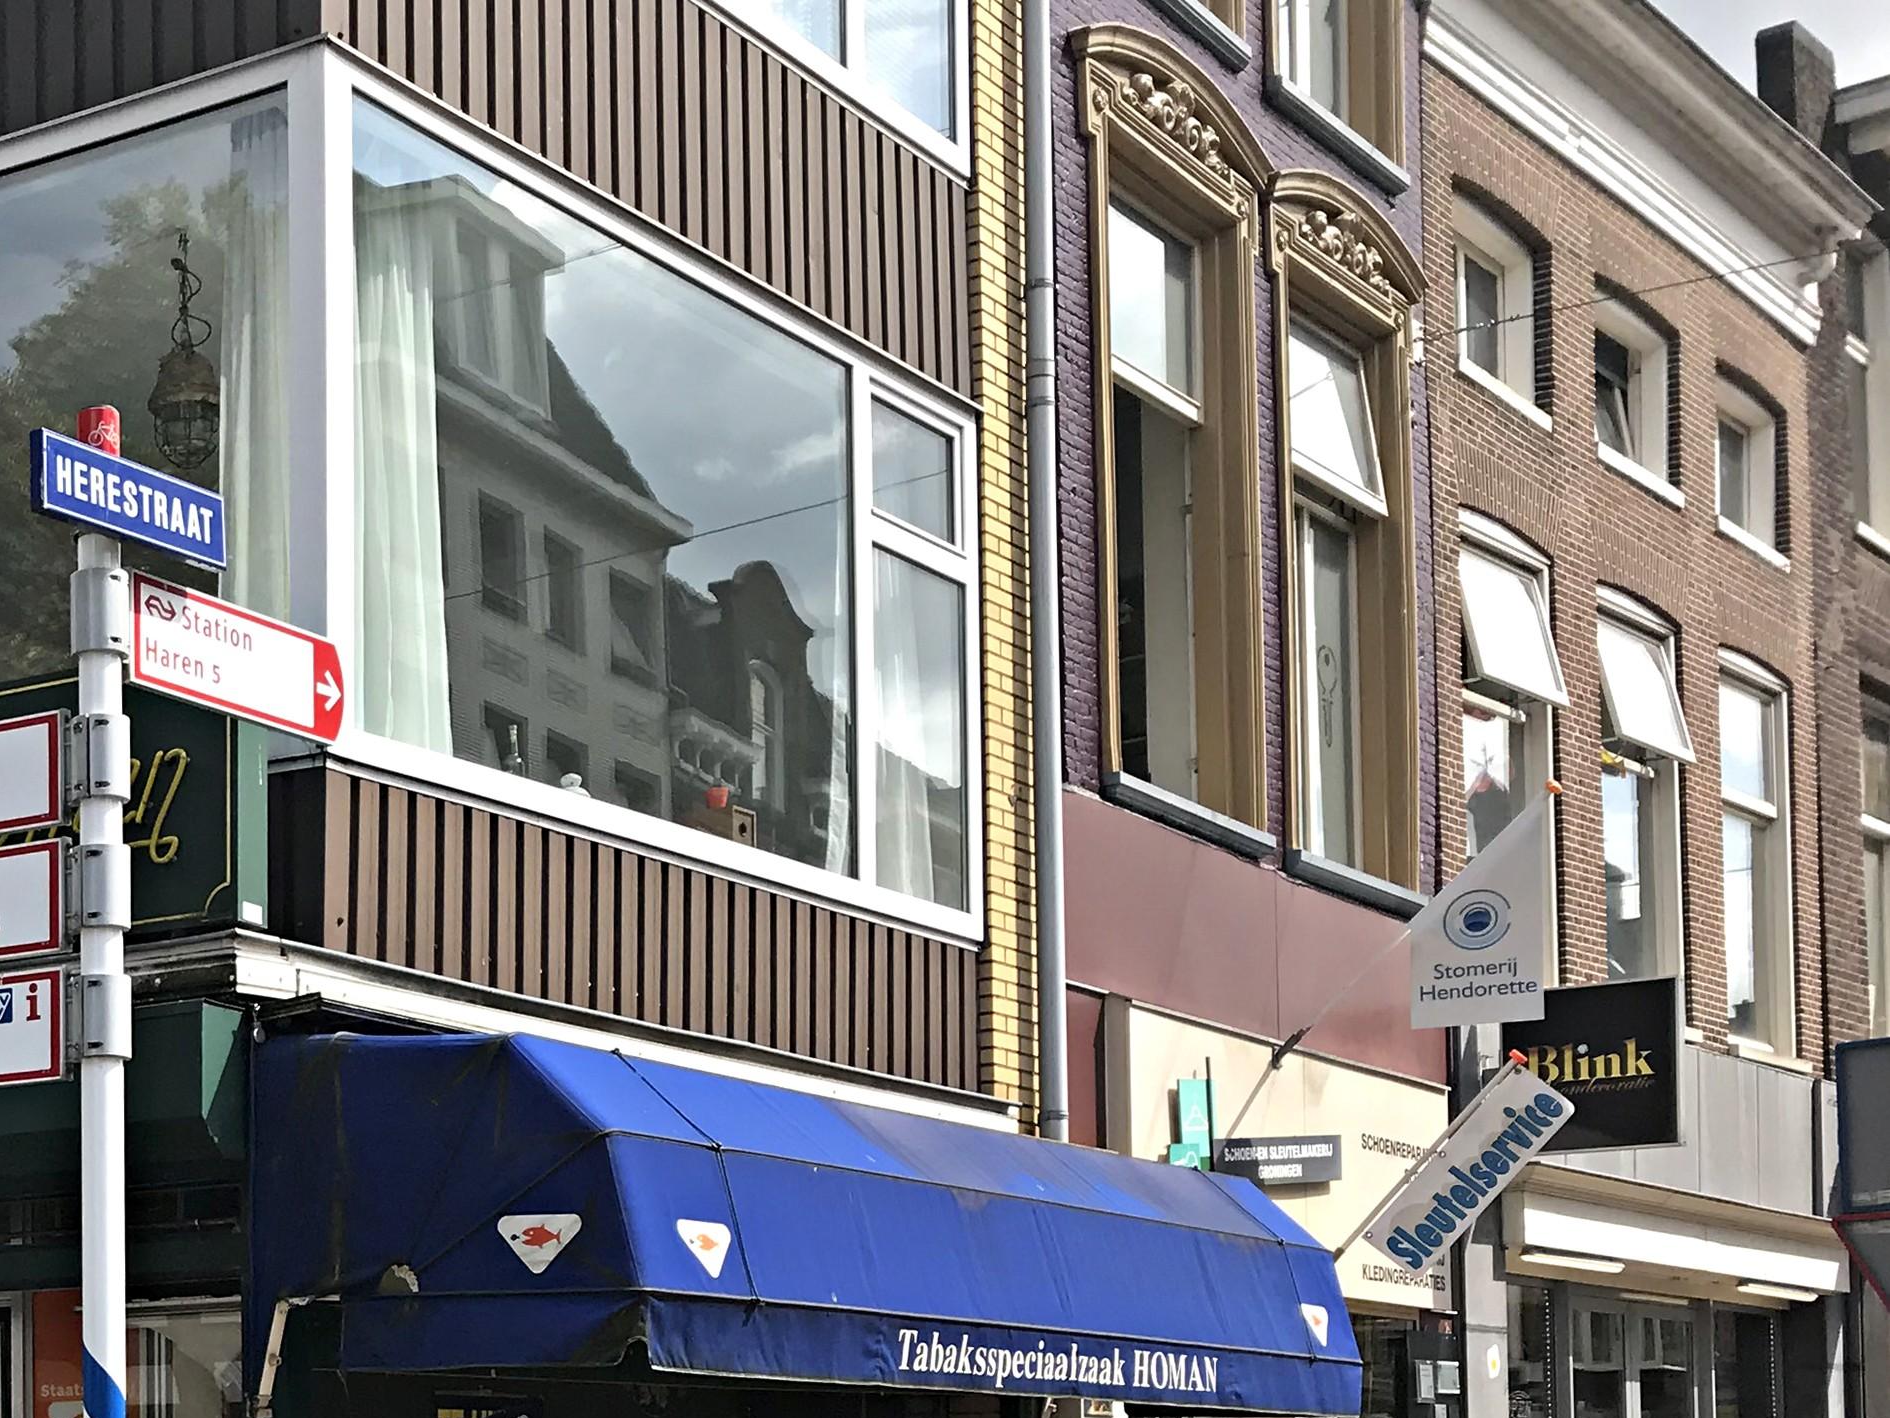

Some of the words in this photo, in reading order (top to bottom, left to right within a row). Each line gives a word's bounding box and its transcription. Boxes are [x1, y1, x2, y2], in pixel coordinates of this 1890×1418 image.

[55, 454, 214, 545] HERESTRAAT
[181, 604, 253, 652] Station
[144, 636, 205, 681] Haren
[212, 665, 222, 684] 5
[1419, 980, 1538, 1002] Hendorette
[1433, 957, 1518, 980] Stomerij
[1528, 1038, 1656, 1084] Blink
[1257, 1163, 1303, 1180] GRONINGEN
[1269, 1143, 1333, 1160] SLEUTELMAKERIJ
[1385, 1092, 1564, 1271] Sleutelservice
[898, 1328, 1126, 1389] Tabaksspeciaalzaak
[1132, 1349, 1219, 1394] HOMAN
[40, 1384, 84, 1398] Staat
